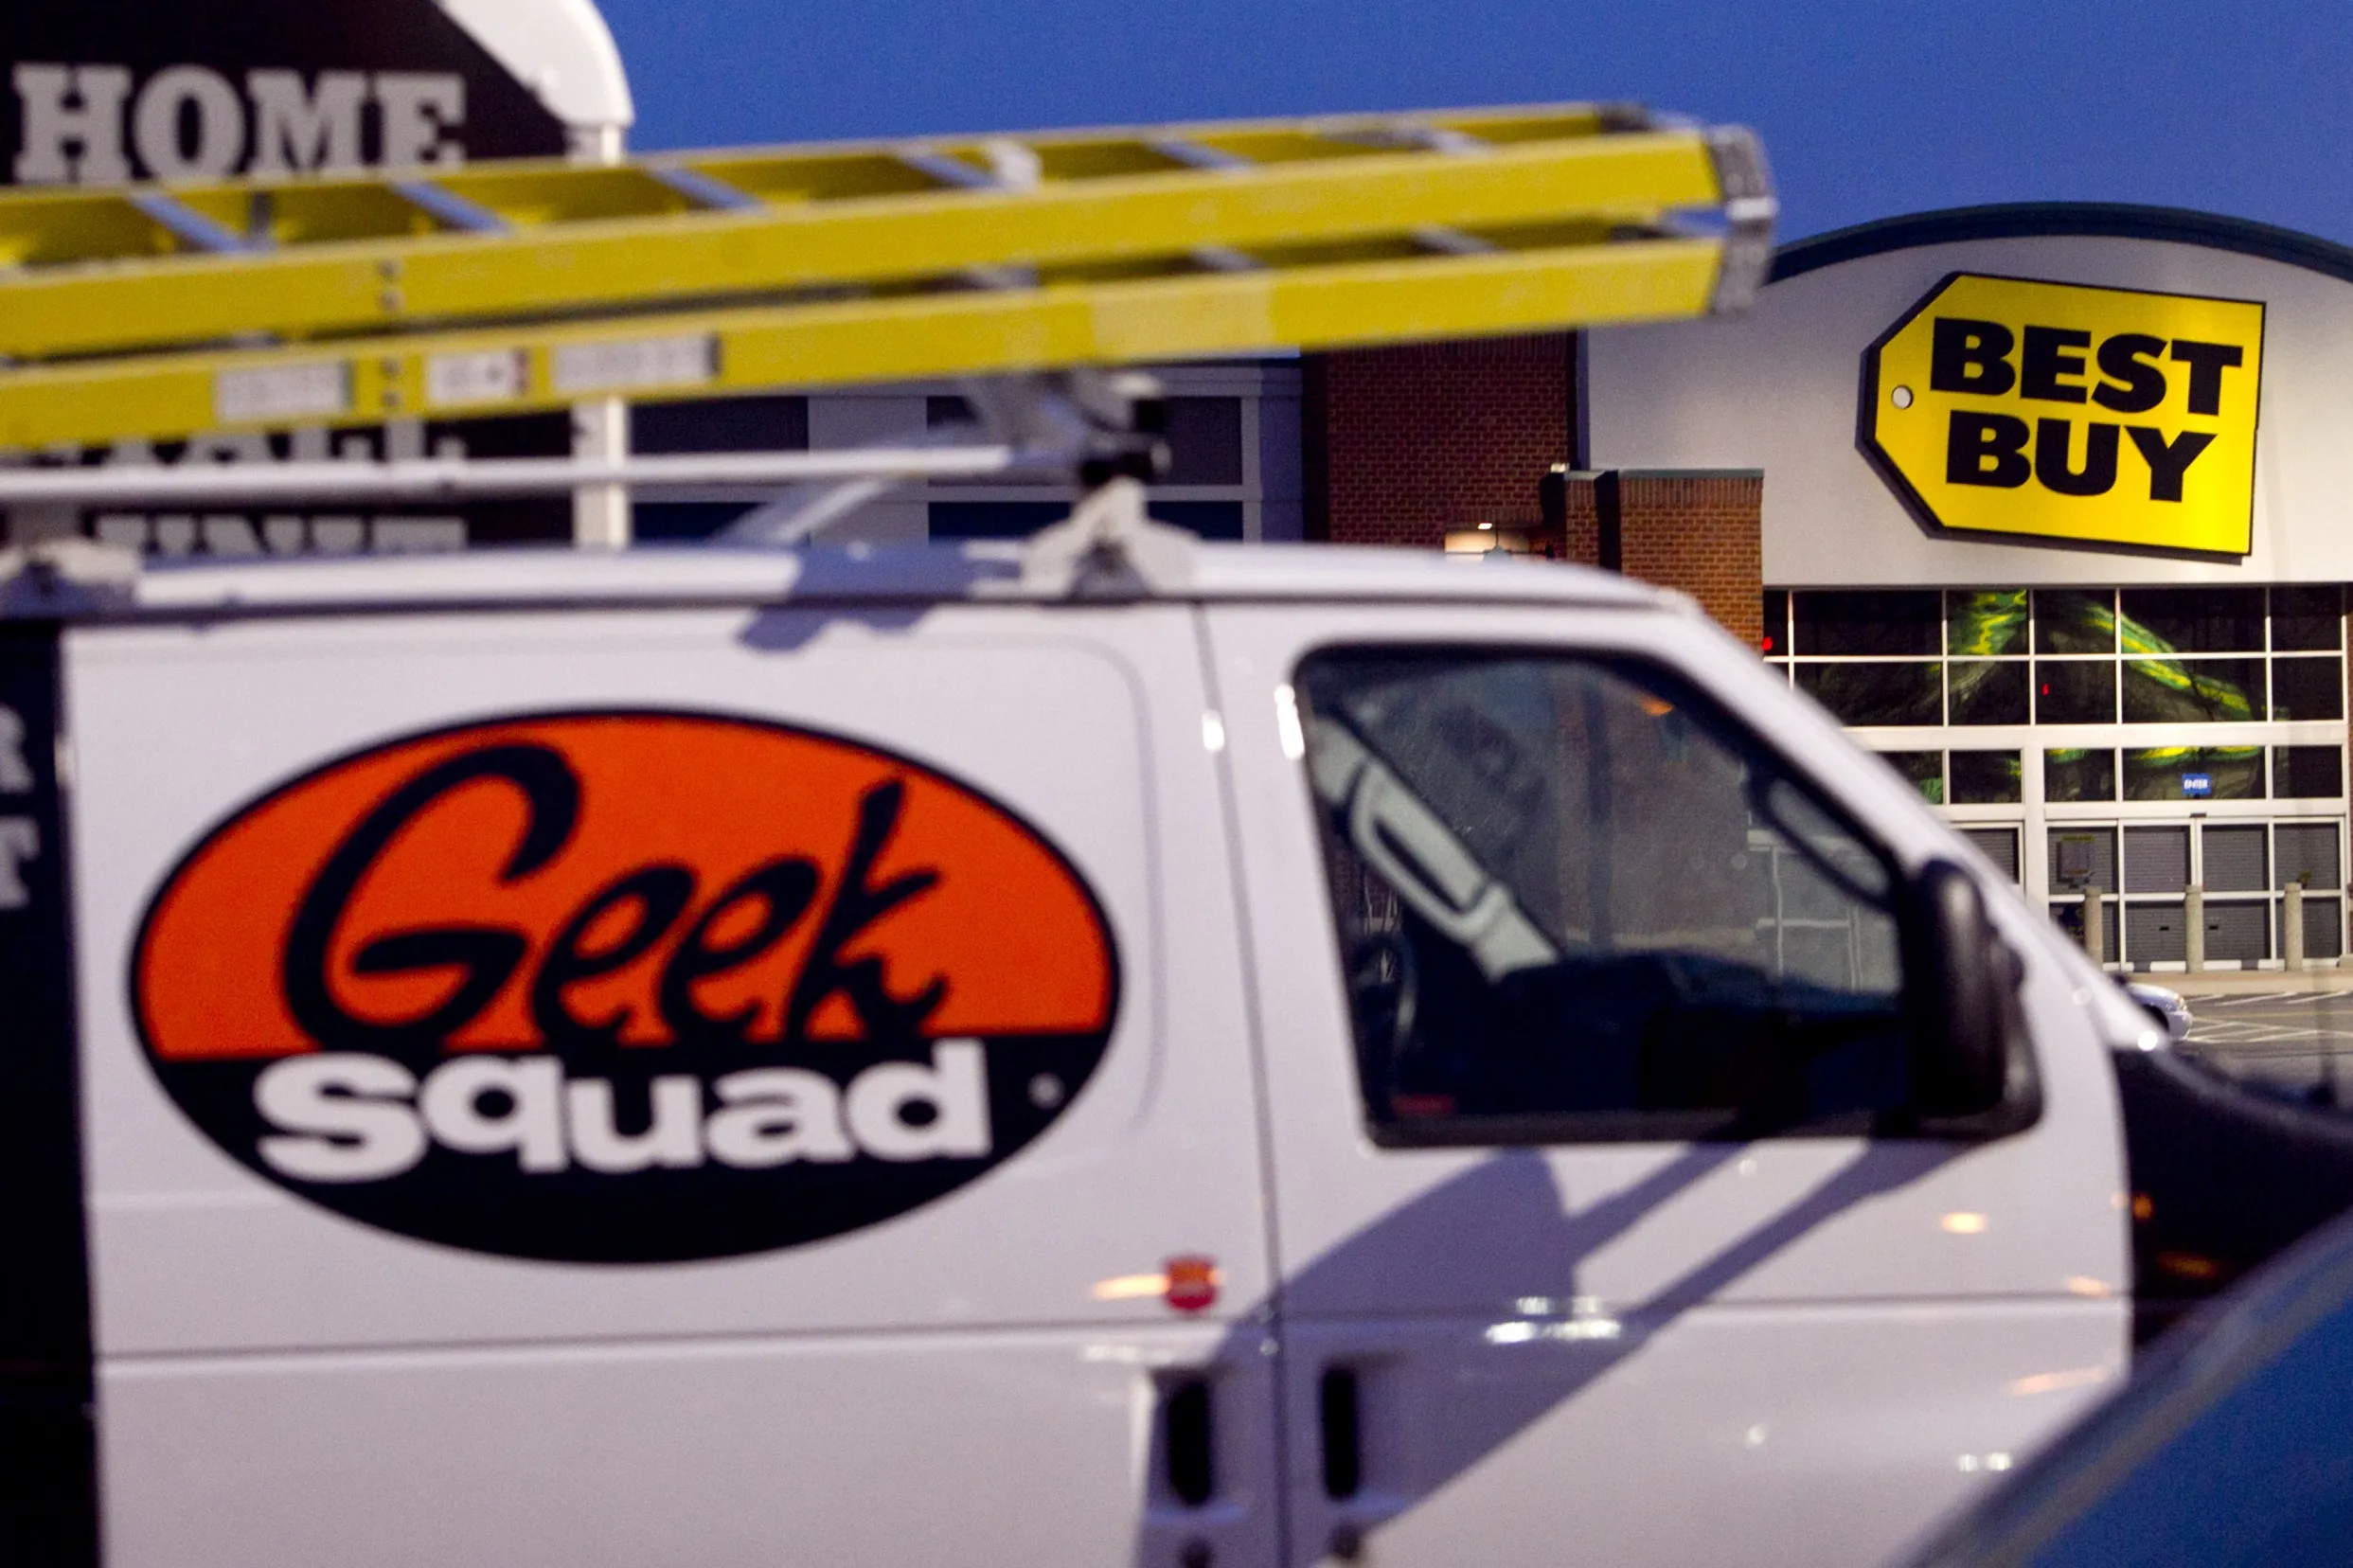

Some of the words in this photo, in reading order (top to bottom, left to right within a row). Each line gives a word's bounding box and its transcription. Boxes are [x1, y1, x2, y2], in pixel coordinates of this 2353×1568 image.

[13, 62, 467, 184] HOME
[1931, 316, 2243, 416] BEST
[1946, 409, 2218, 503] BUY
[277, 741, 948, 1046] Geek
